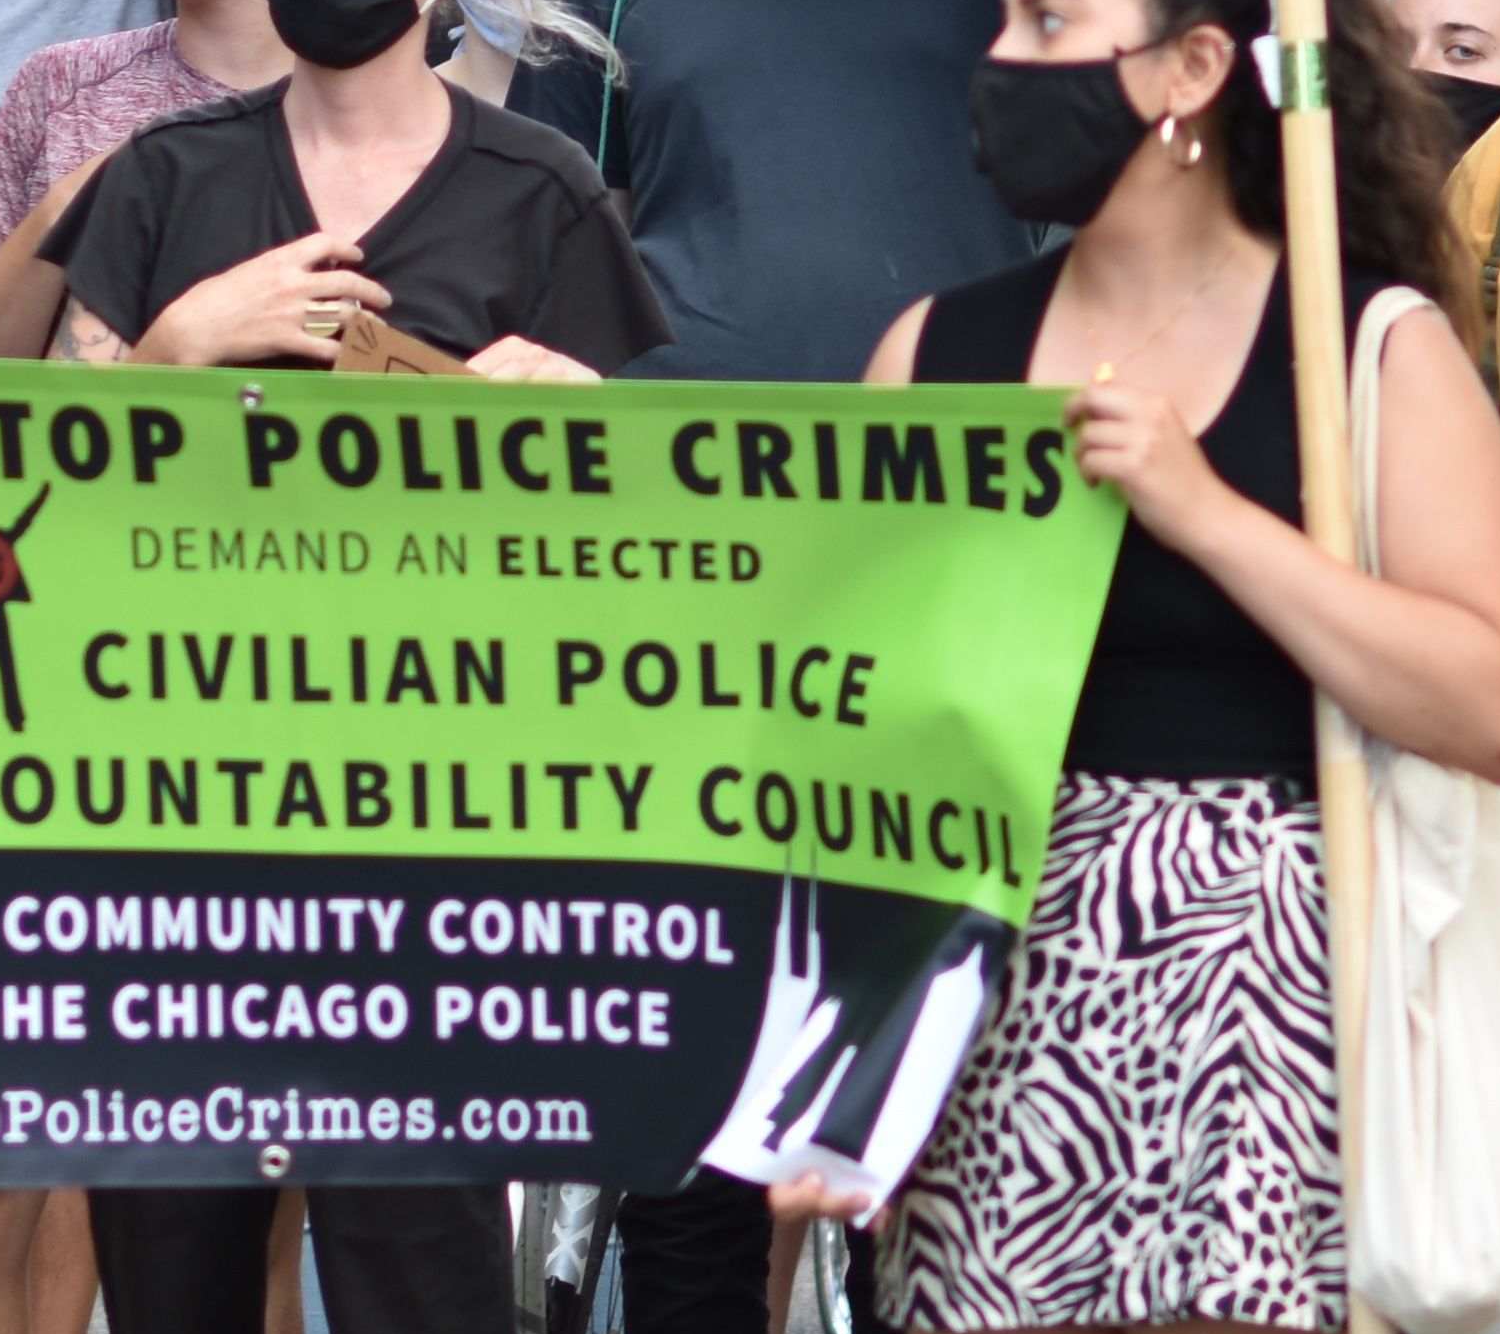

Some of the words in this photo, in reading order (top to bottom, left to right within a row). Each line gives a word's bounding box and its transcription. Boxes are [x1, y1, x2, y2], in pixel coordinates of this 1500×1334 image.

[247, 411, 612, 495] POLICE
[670, 420, 1066, 520] CRIMES
[131, 526, 372, 576] DEMAND
[395, 533, 470, 576] AN
[497, 535, 763, 583] ELECTED
[83, 631, 506, 706] CIVILIAN
[556, 638, 878, 727] POLICE
[698, 764, 1024, 889] COUNCIL
[2, 897, 406, 955] COMMUNITY
[427, 898, 735, 966] CONTROL
[110, 984, 411, 1041] CHICAGO
[434, 985, 671, 1048] POLICE
